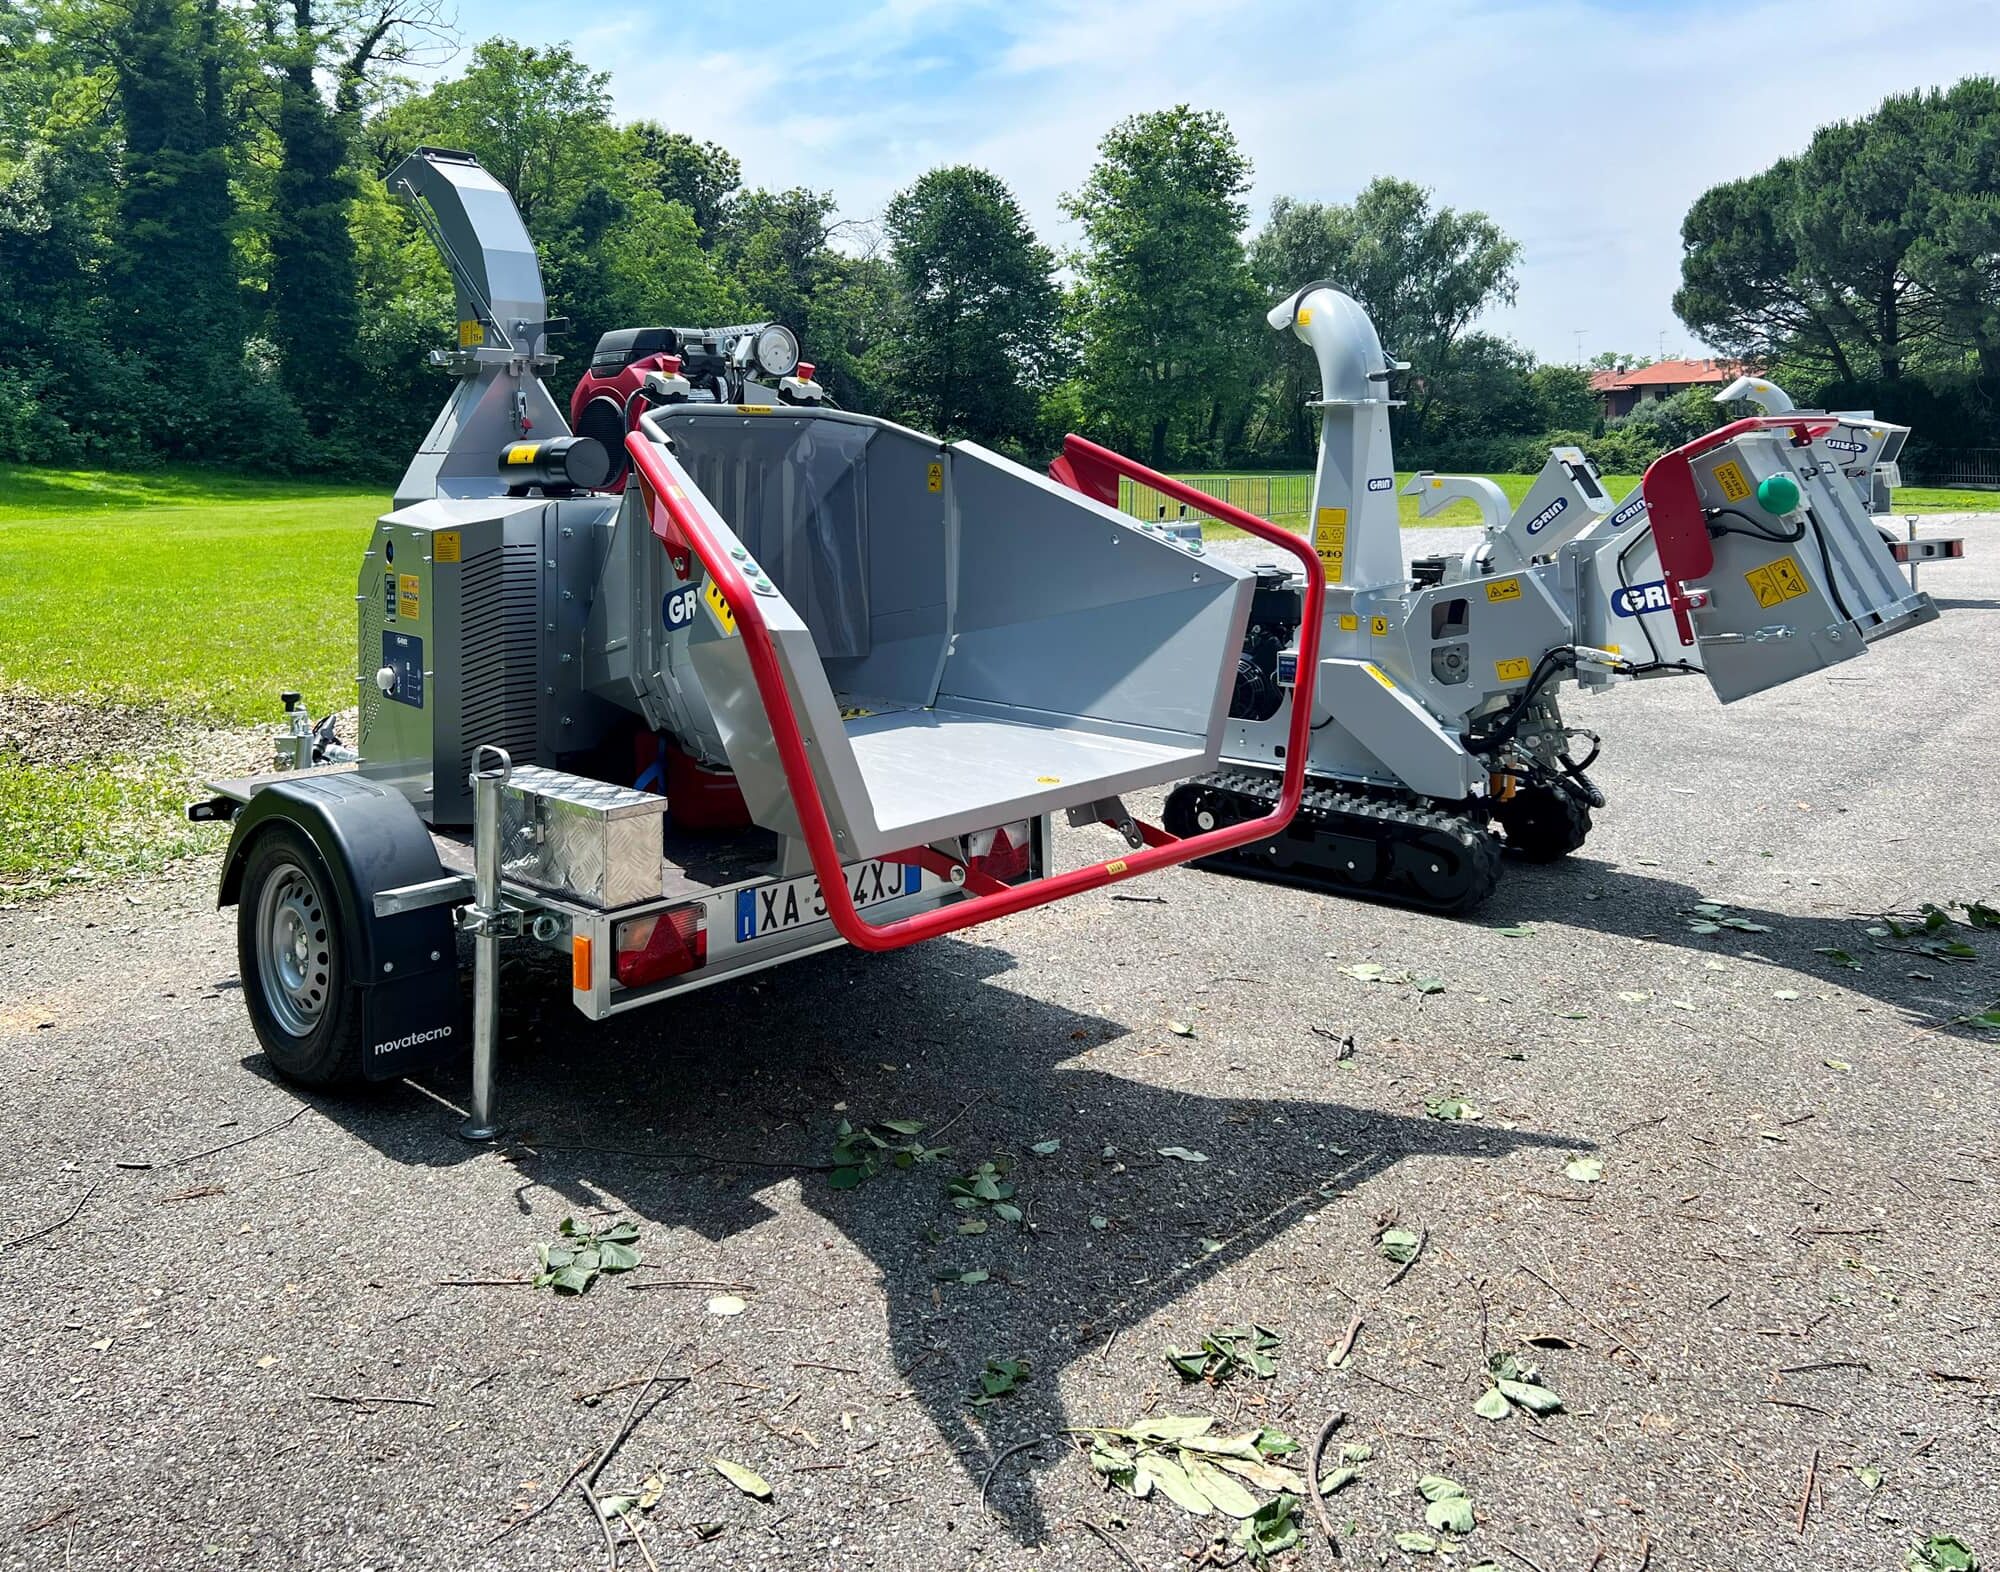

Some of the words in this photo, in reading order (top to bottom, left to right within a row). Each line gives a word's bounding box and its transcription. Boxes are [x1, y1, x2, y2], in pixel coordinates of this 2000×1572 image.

[1369, 480, 1390, 490] GRIN
[1531, 502, 1564, 530] GRIN
[669, 587, 701, 623] GR
[761, 885, 799, 932] XA
[375, 1026, 452, 1055] novatecno
